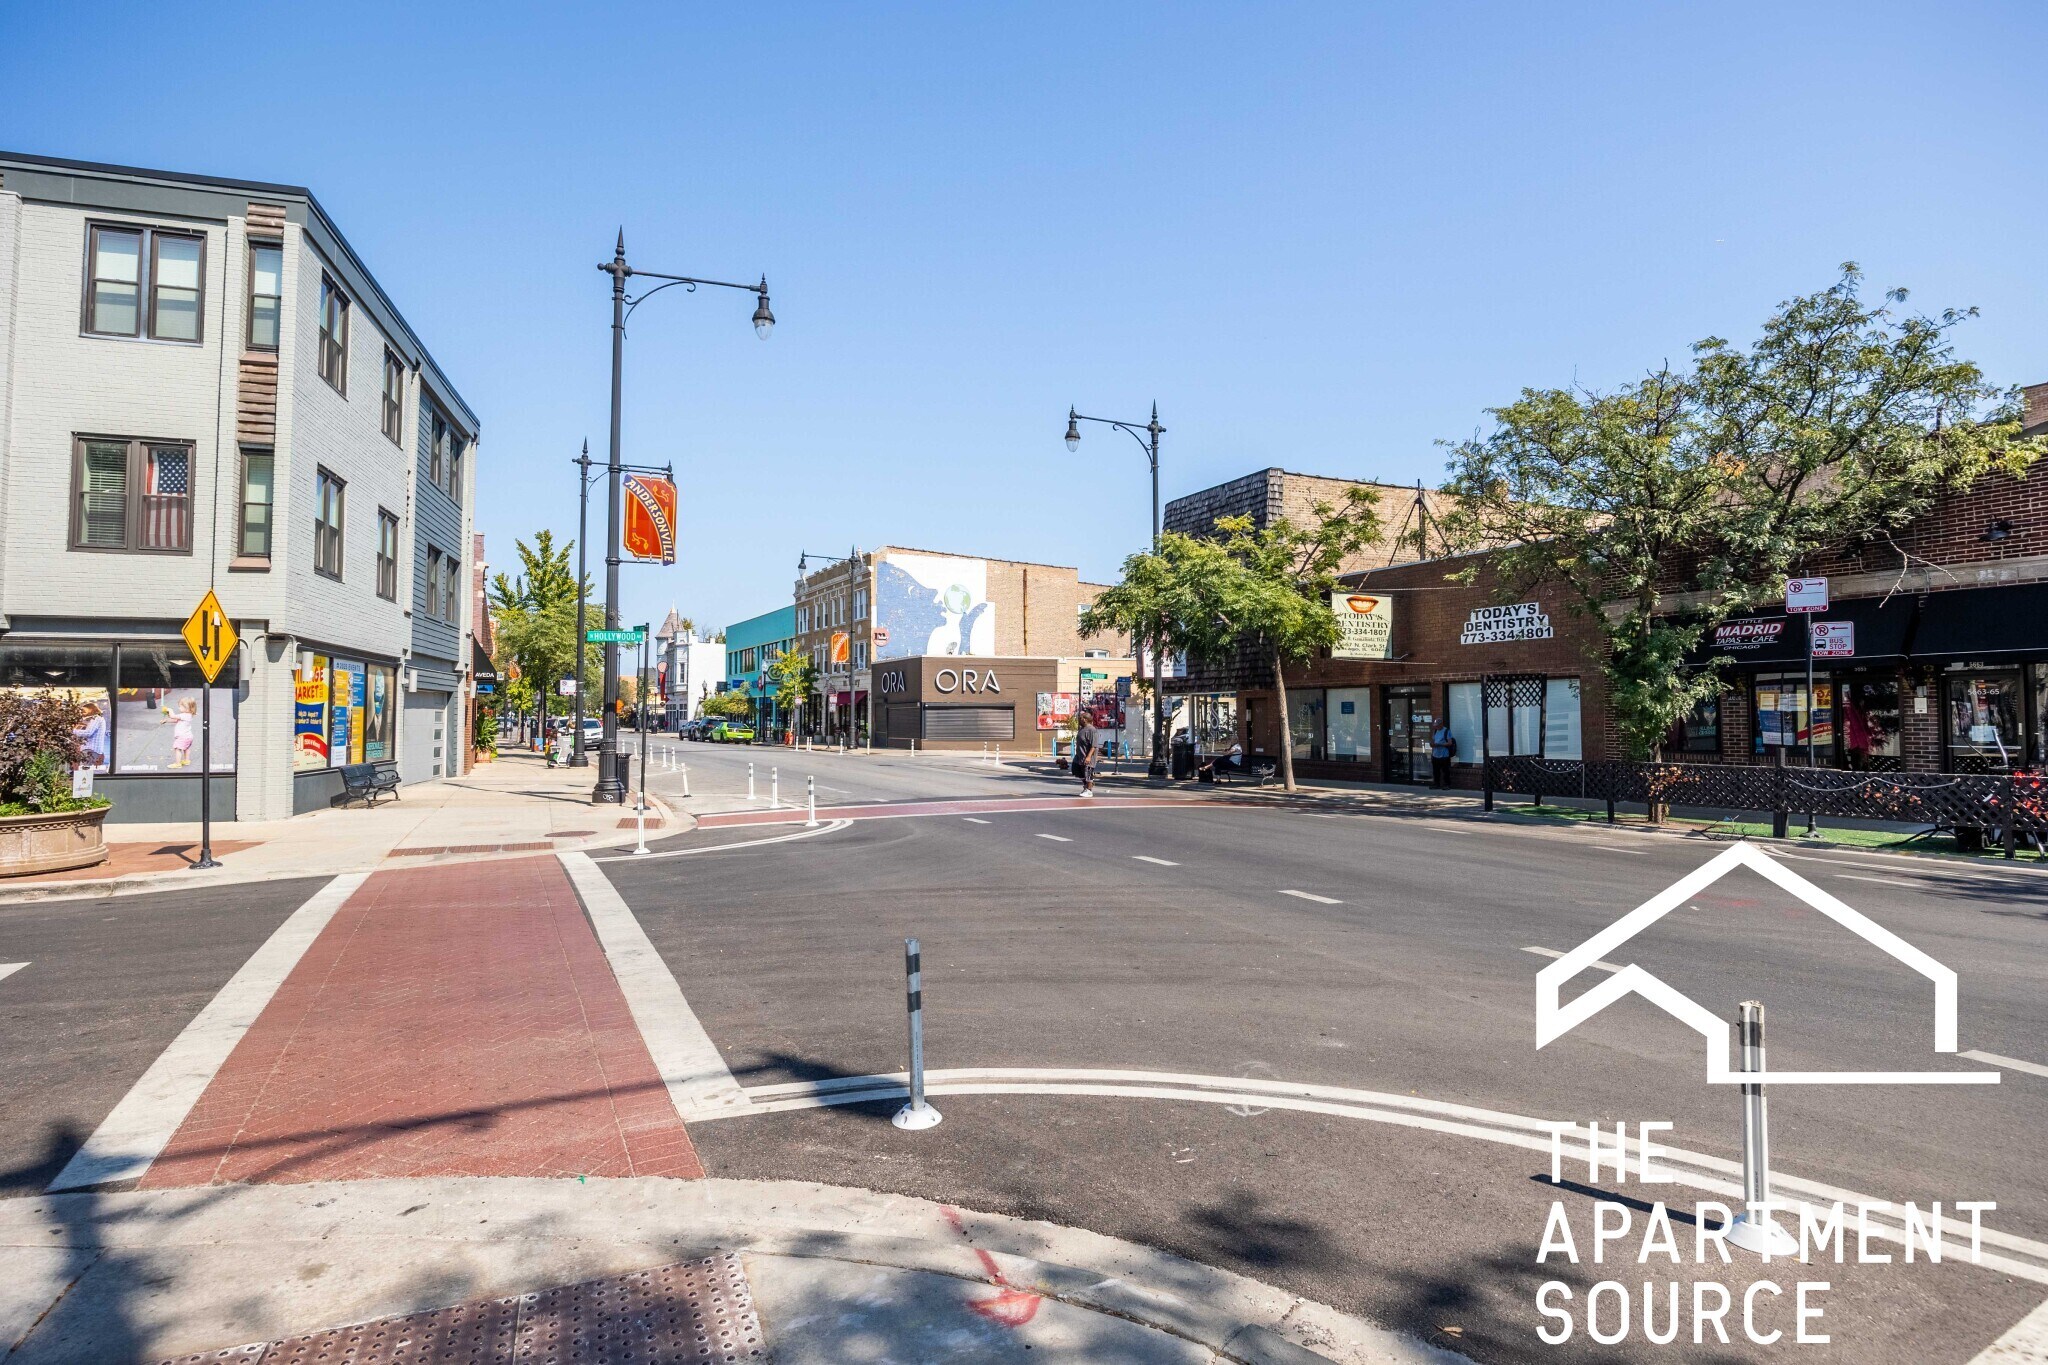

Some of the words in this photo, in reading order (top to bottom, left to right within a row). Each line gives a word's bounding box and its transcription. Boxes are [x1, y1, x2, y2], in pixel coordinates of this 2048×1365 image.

[625, 479, 674, 562] ANDERSONVILLE
[1341, 613, 1383, 621] TODAY'S
[1472, 603, 1537, 620] TODAY'S
[1465, 615, 1546, 632] DENTISTRY
[1715, 623, 1782, 638] MADRID
[594, 632, 636, 641] HOLLYWOOD
[1462, 627, 1552, 643] 773-334-1801
[1715, 636, 1742, 645] TAPAS
[1751, 635, 1775, 643] CAFE
[881, 670, 906, 694] ORA
[935, 668, 1001, 692] ORA
[1967, 688, 2000, 696] 5663-65
